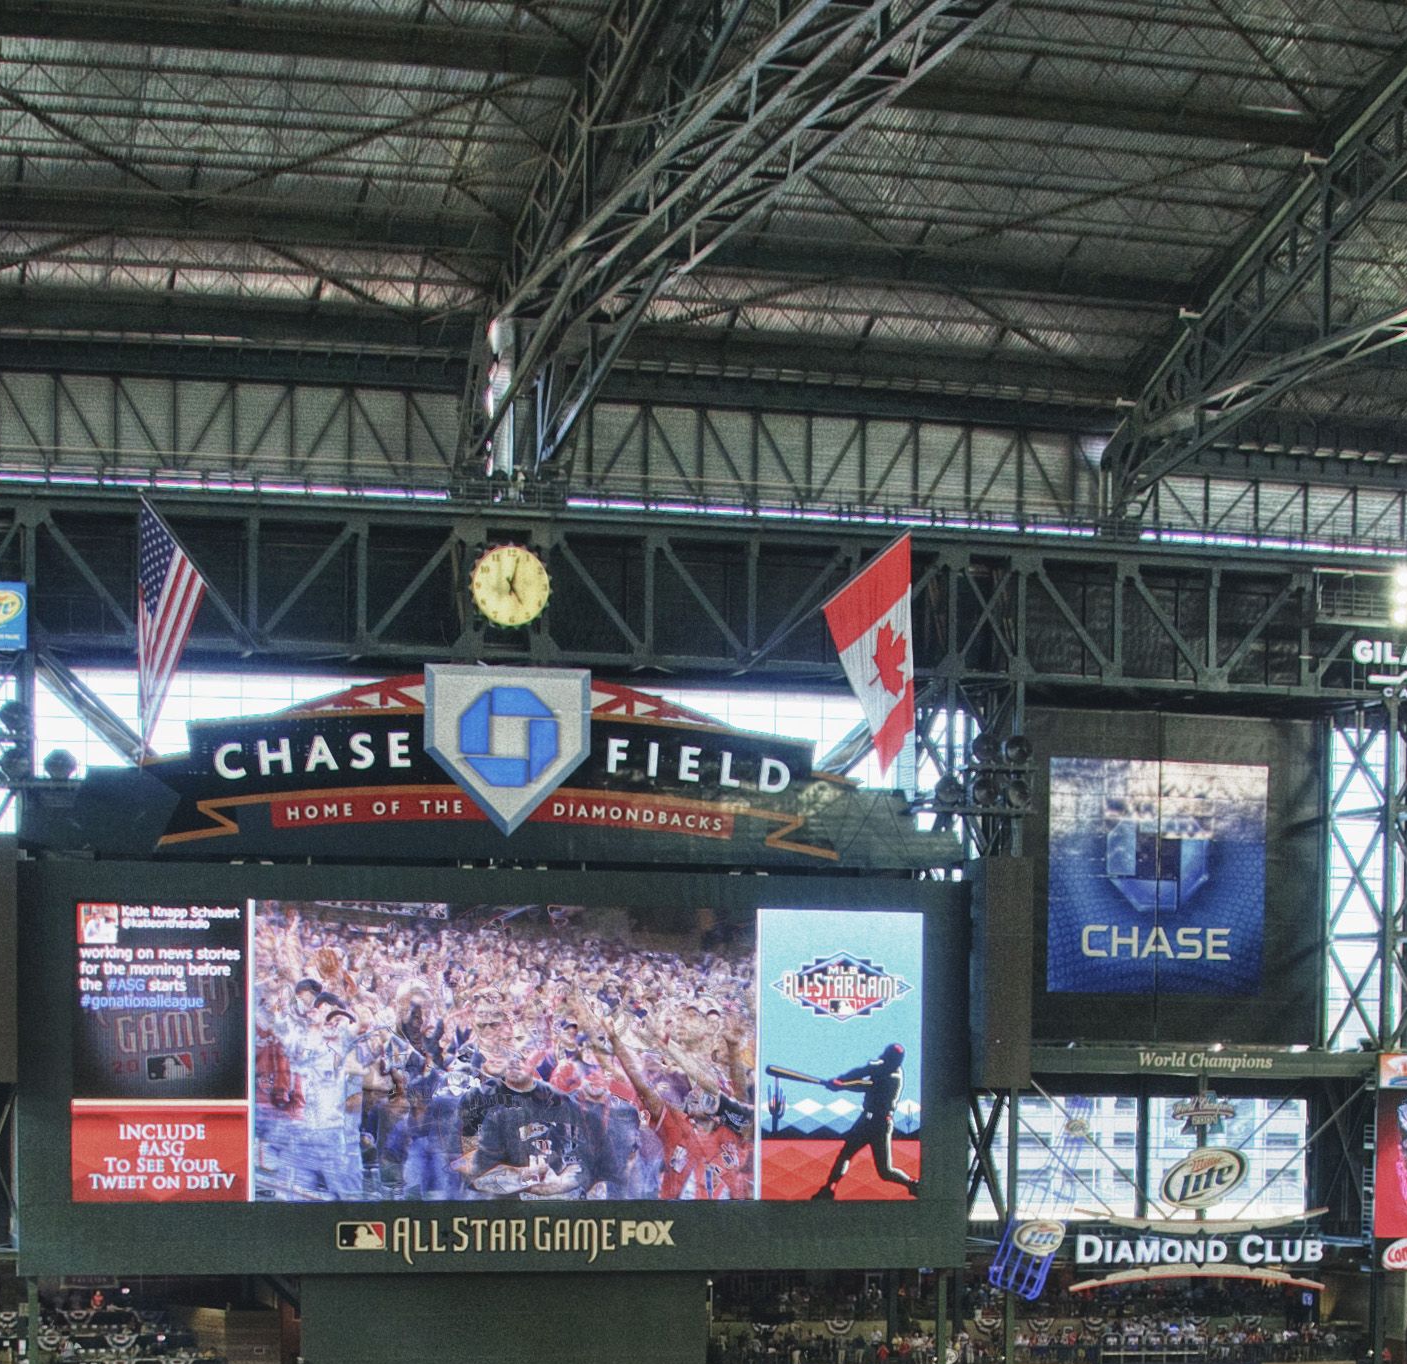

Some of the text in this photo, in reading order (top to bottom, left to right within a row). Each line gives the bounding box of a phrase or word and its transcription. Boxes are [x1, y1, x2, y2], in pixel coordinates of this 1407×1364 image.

[213, 731, 792, 794] CHASE FIELD
[286, 800, 724, 832] HOME OF THE DIAMONDBACKS
[121, 904, 240, 921] Katie Knapp Schubert
[1080, 924, 1232, 962] CHASE
[79, 947, 241, 962] working on news stories
[79, 963, 232, 979] for the morning before
[826, 965, 859, 975] MLB
[79, 979, 187, 992] the #ASG starts
[80, 993, 205, 1010] #gonationalleague
[115, 1007, 216, 1054] GAME
[1139, 1052, 1274, 1071] World Champions
[119, 1124, 206, 1140] INCLUDE
[138, 1140, 185, 1156] #ASG
[394, 1216, 676, 1265] ALL STAR GAME FOX
[1076, 1235, 1324, 1264] DIAMOND CLUB
